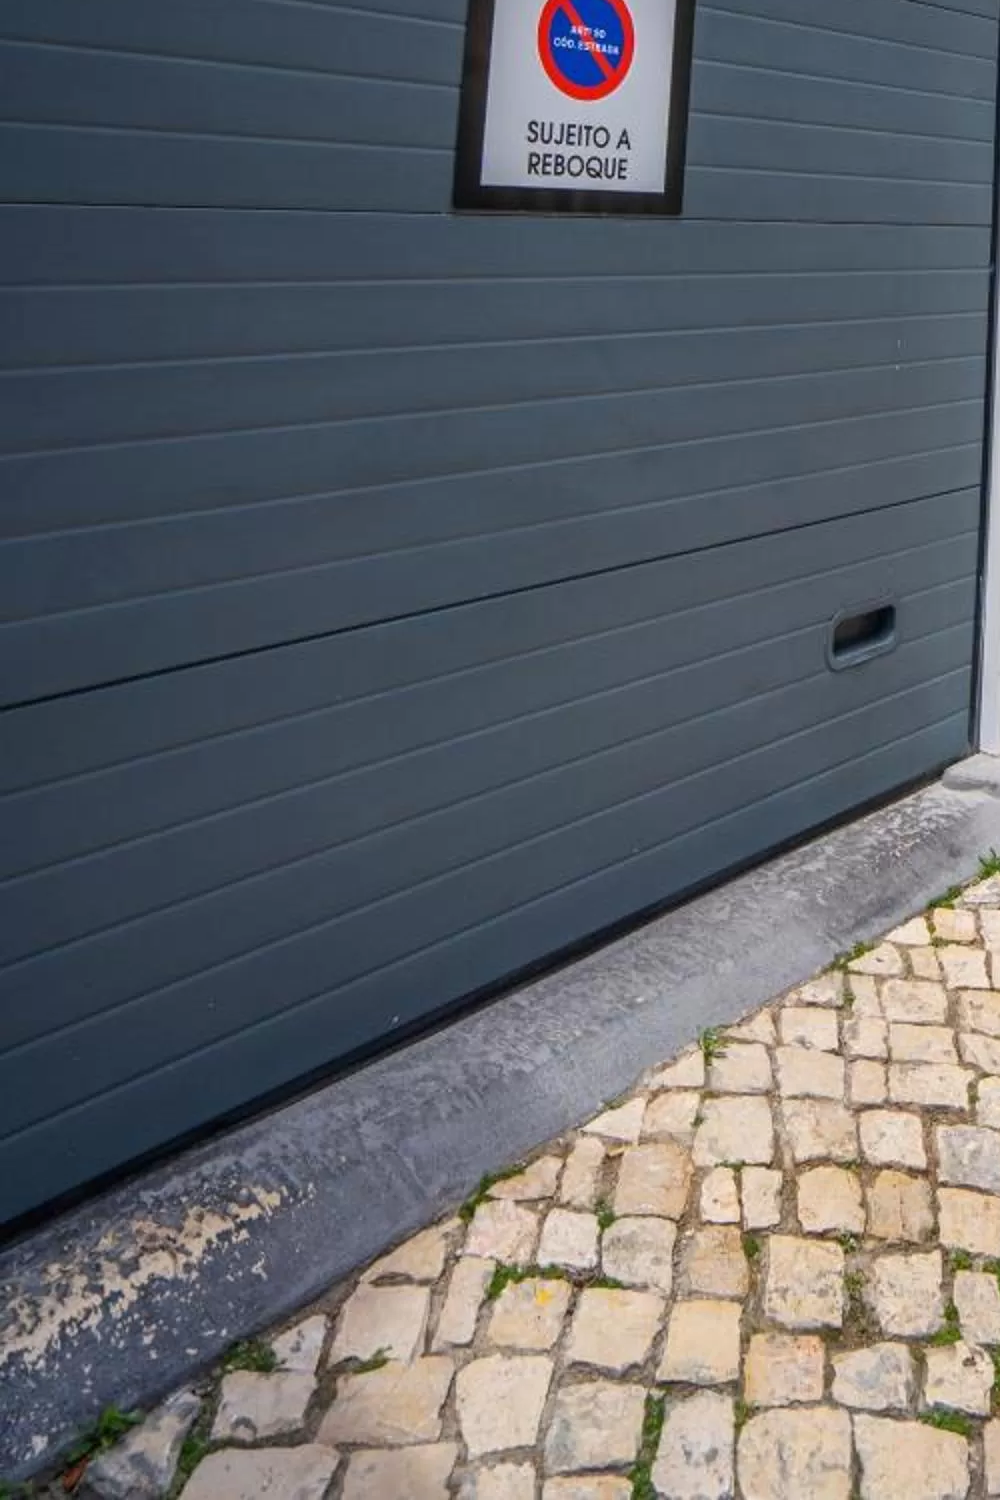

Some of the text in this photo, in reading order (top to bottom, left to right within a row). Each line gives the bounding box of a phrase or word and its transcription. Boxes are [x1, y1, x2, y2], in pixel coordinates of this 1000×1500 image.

[527, 119, 631, 151] SUJEITO A
[527, 152, 628, 180] REBOQUE
